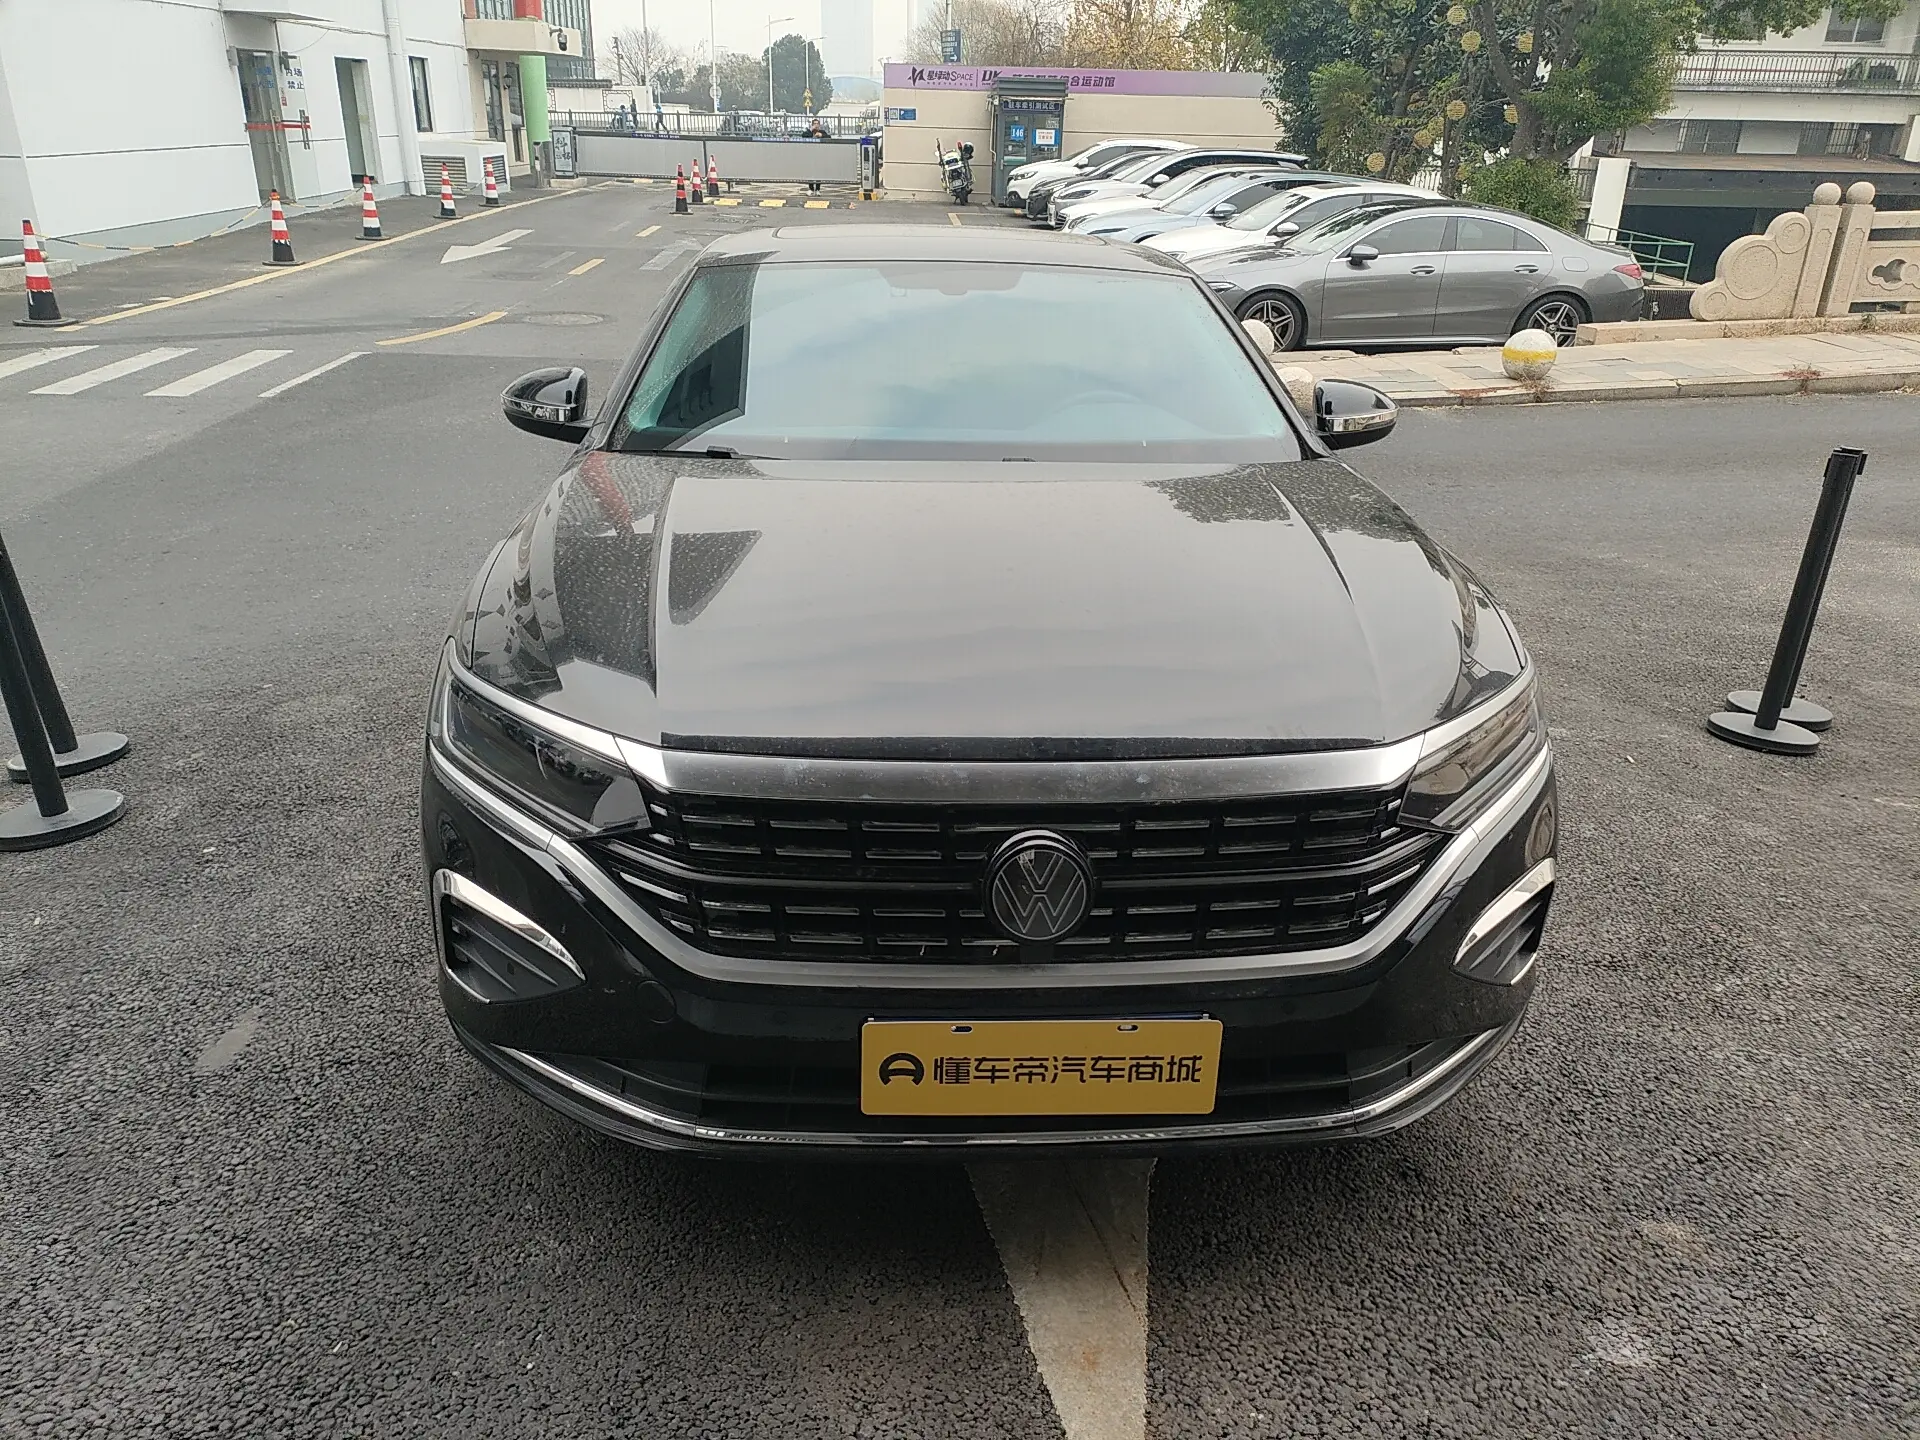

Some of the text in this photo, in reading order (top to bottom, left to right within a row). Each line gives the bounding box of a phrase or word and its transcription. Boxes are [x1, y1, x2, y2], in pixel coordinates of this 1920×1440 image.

[287, 81, 305, 90] 禁止
[1012, 128, 1024, 137] 146
[933, 1055, 1203, 1085] 懂车帝汽车商城
